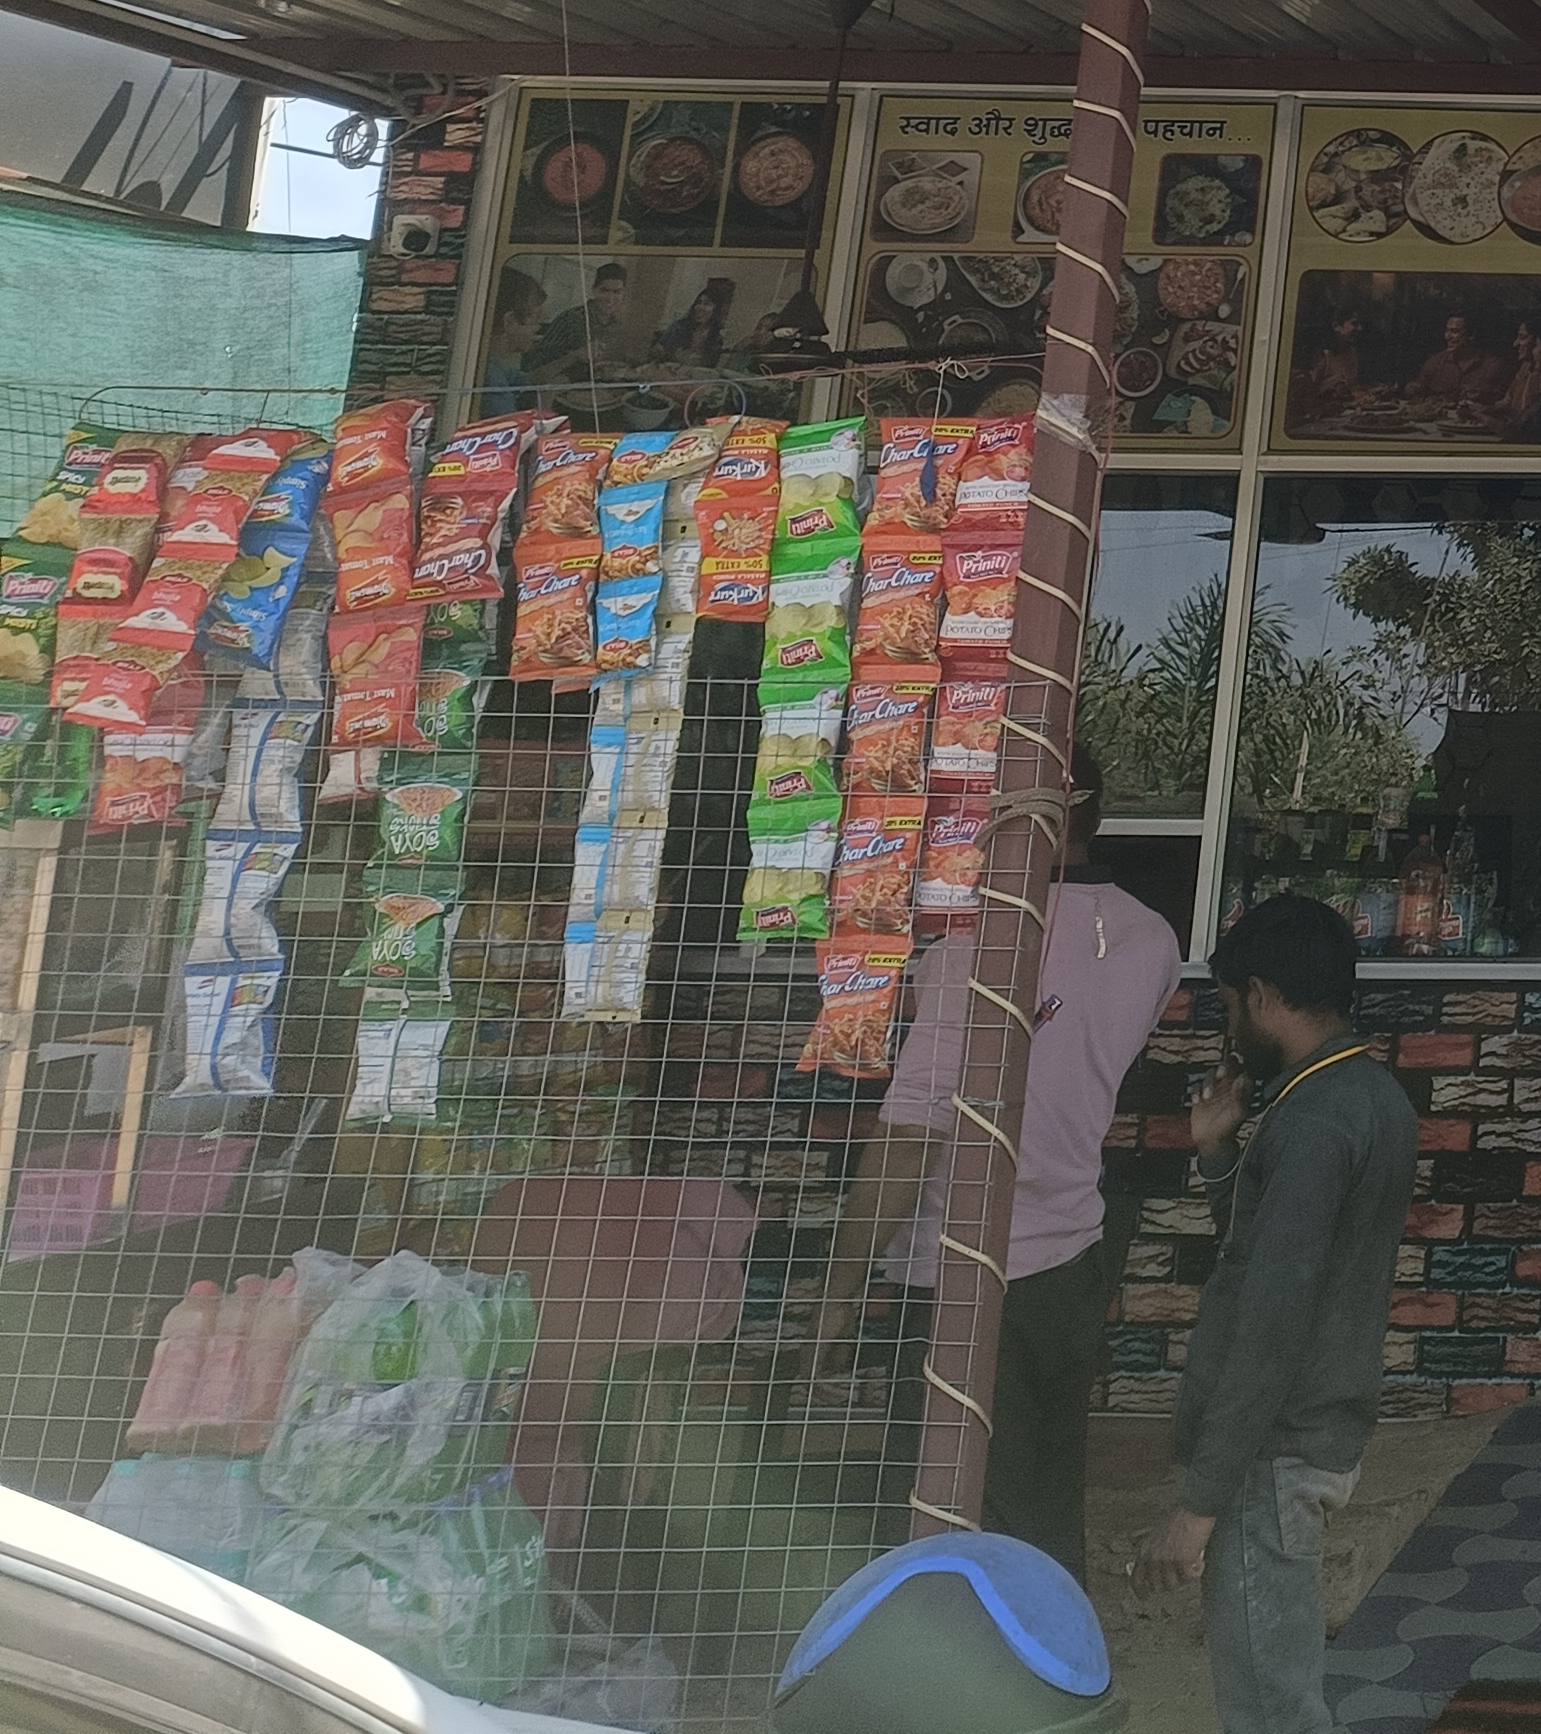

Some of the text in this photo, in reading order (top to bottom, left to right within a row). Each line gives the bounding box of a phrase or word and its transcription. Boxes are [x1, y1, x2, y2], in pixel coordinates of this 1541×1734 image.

[898, 111, 959, 137] स्वाद
[966, 110, 1013, 137] और
[979, 427, 1018, 447] Priniti
[791, 514, 828, 535] Priniti
[715, 559, 763, 570] 50% EXTRA
[962, 554, 1006, 574] Priniti
[6, 579, 54, 596] Priniti
[945, 624, 982, 636] POTATO
[782, 644, 818, 665] Priniti
[952, 687, 995, 705] Priniti
[389, 828, 440, 855] SOYA
[371, 939, 416, 961] SOYA
